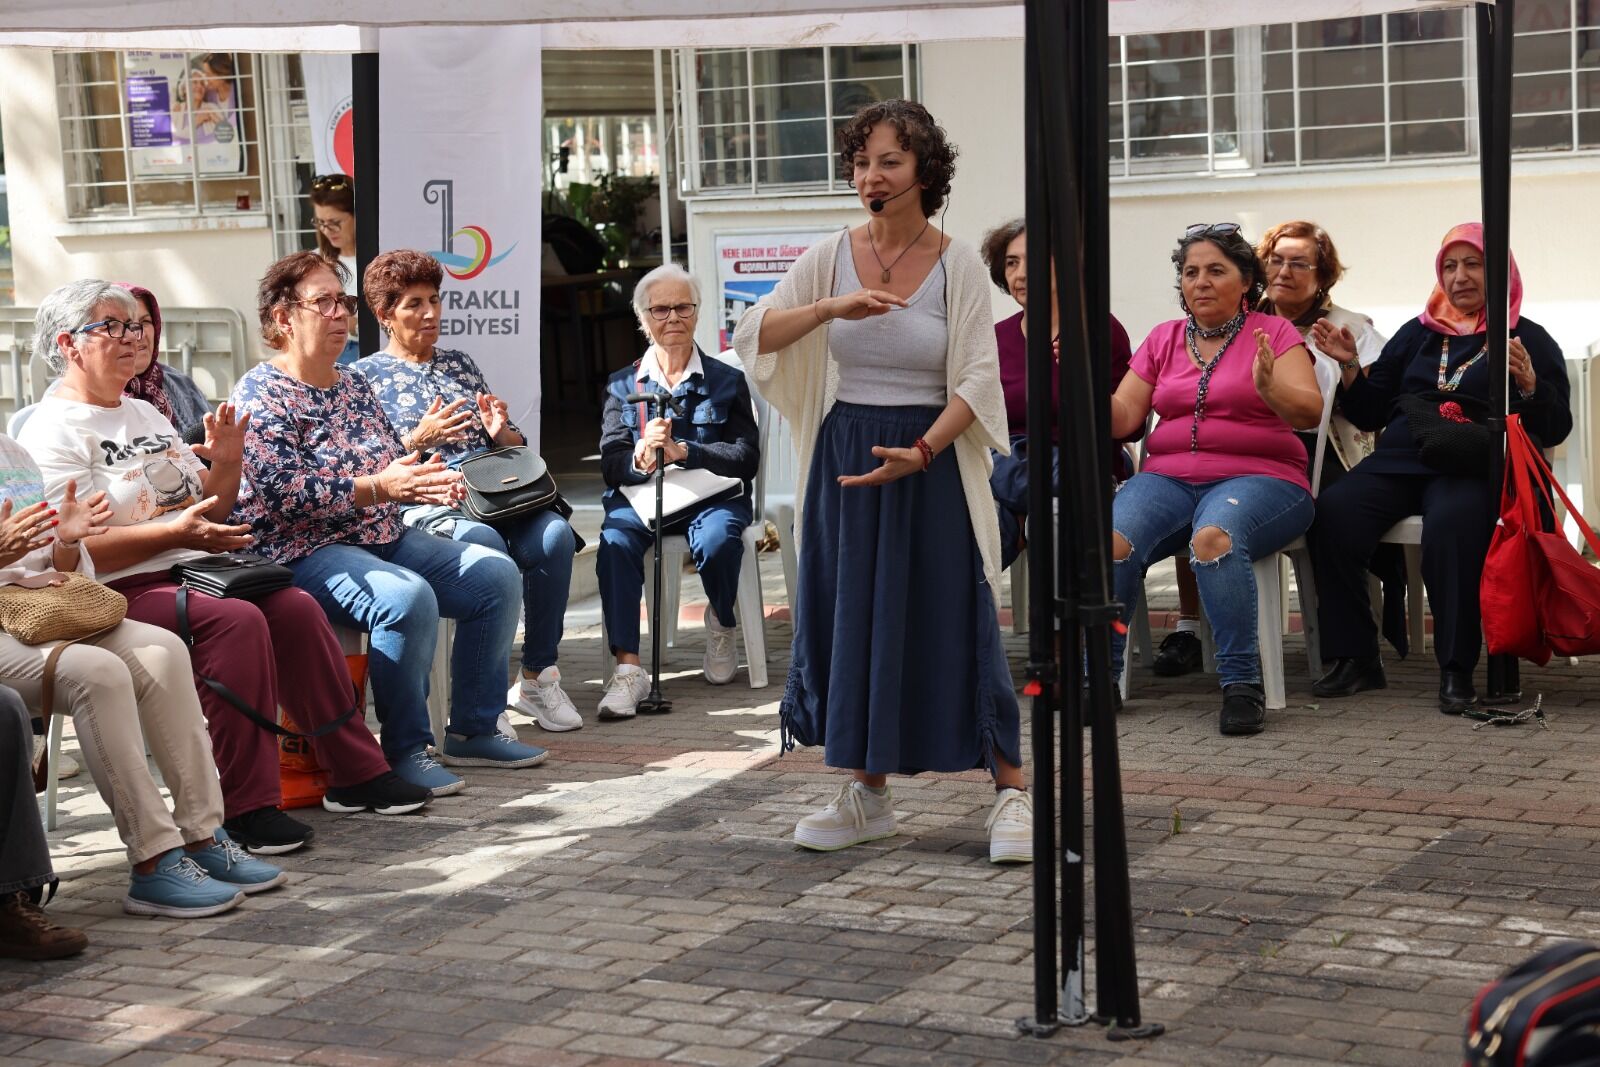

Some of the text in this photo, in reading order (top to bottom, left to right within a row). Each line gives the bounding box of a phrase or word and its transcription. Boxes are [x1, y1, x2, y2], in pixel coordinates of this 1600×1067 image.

[722, 244, 809, 258] NENE HATUN KIZ ÖĞRENC
